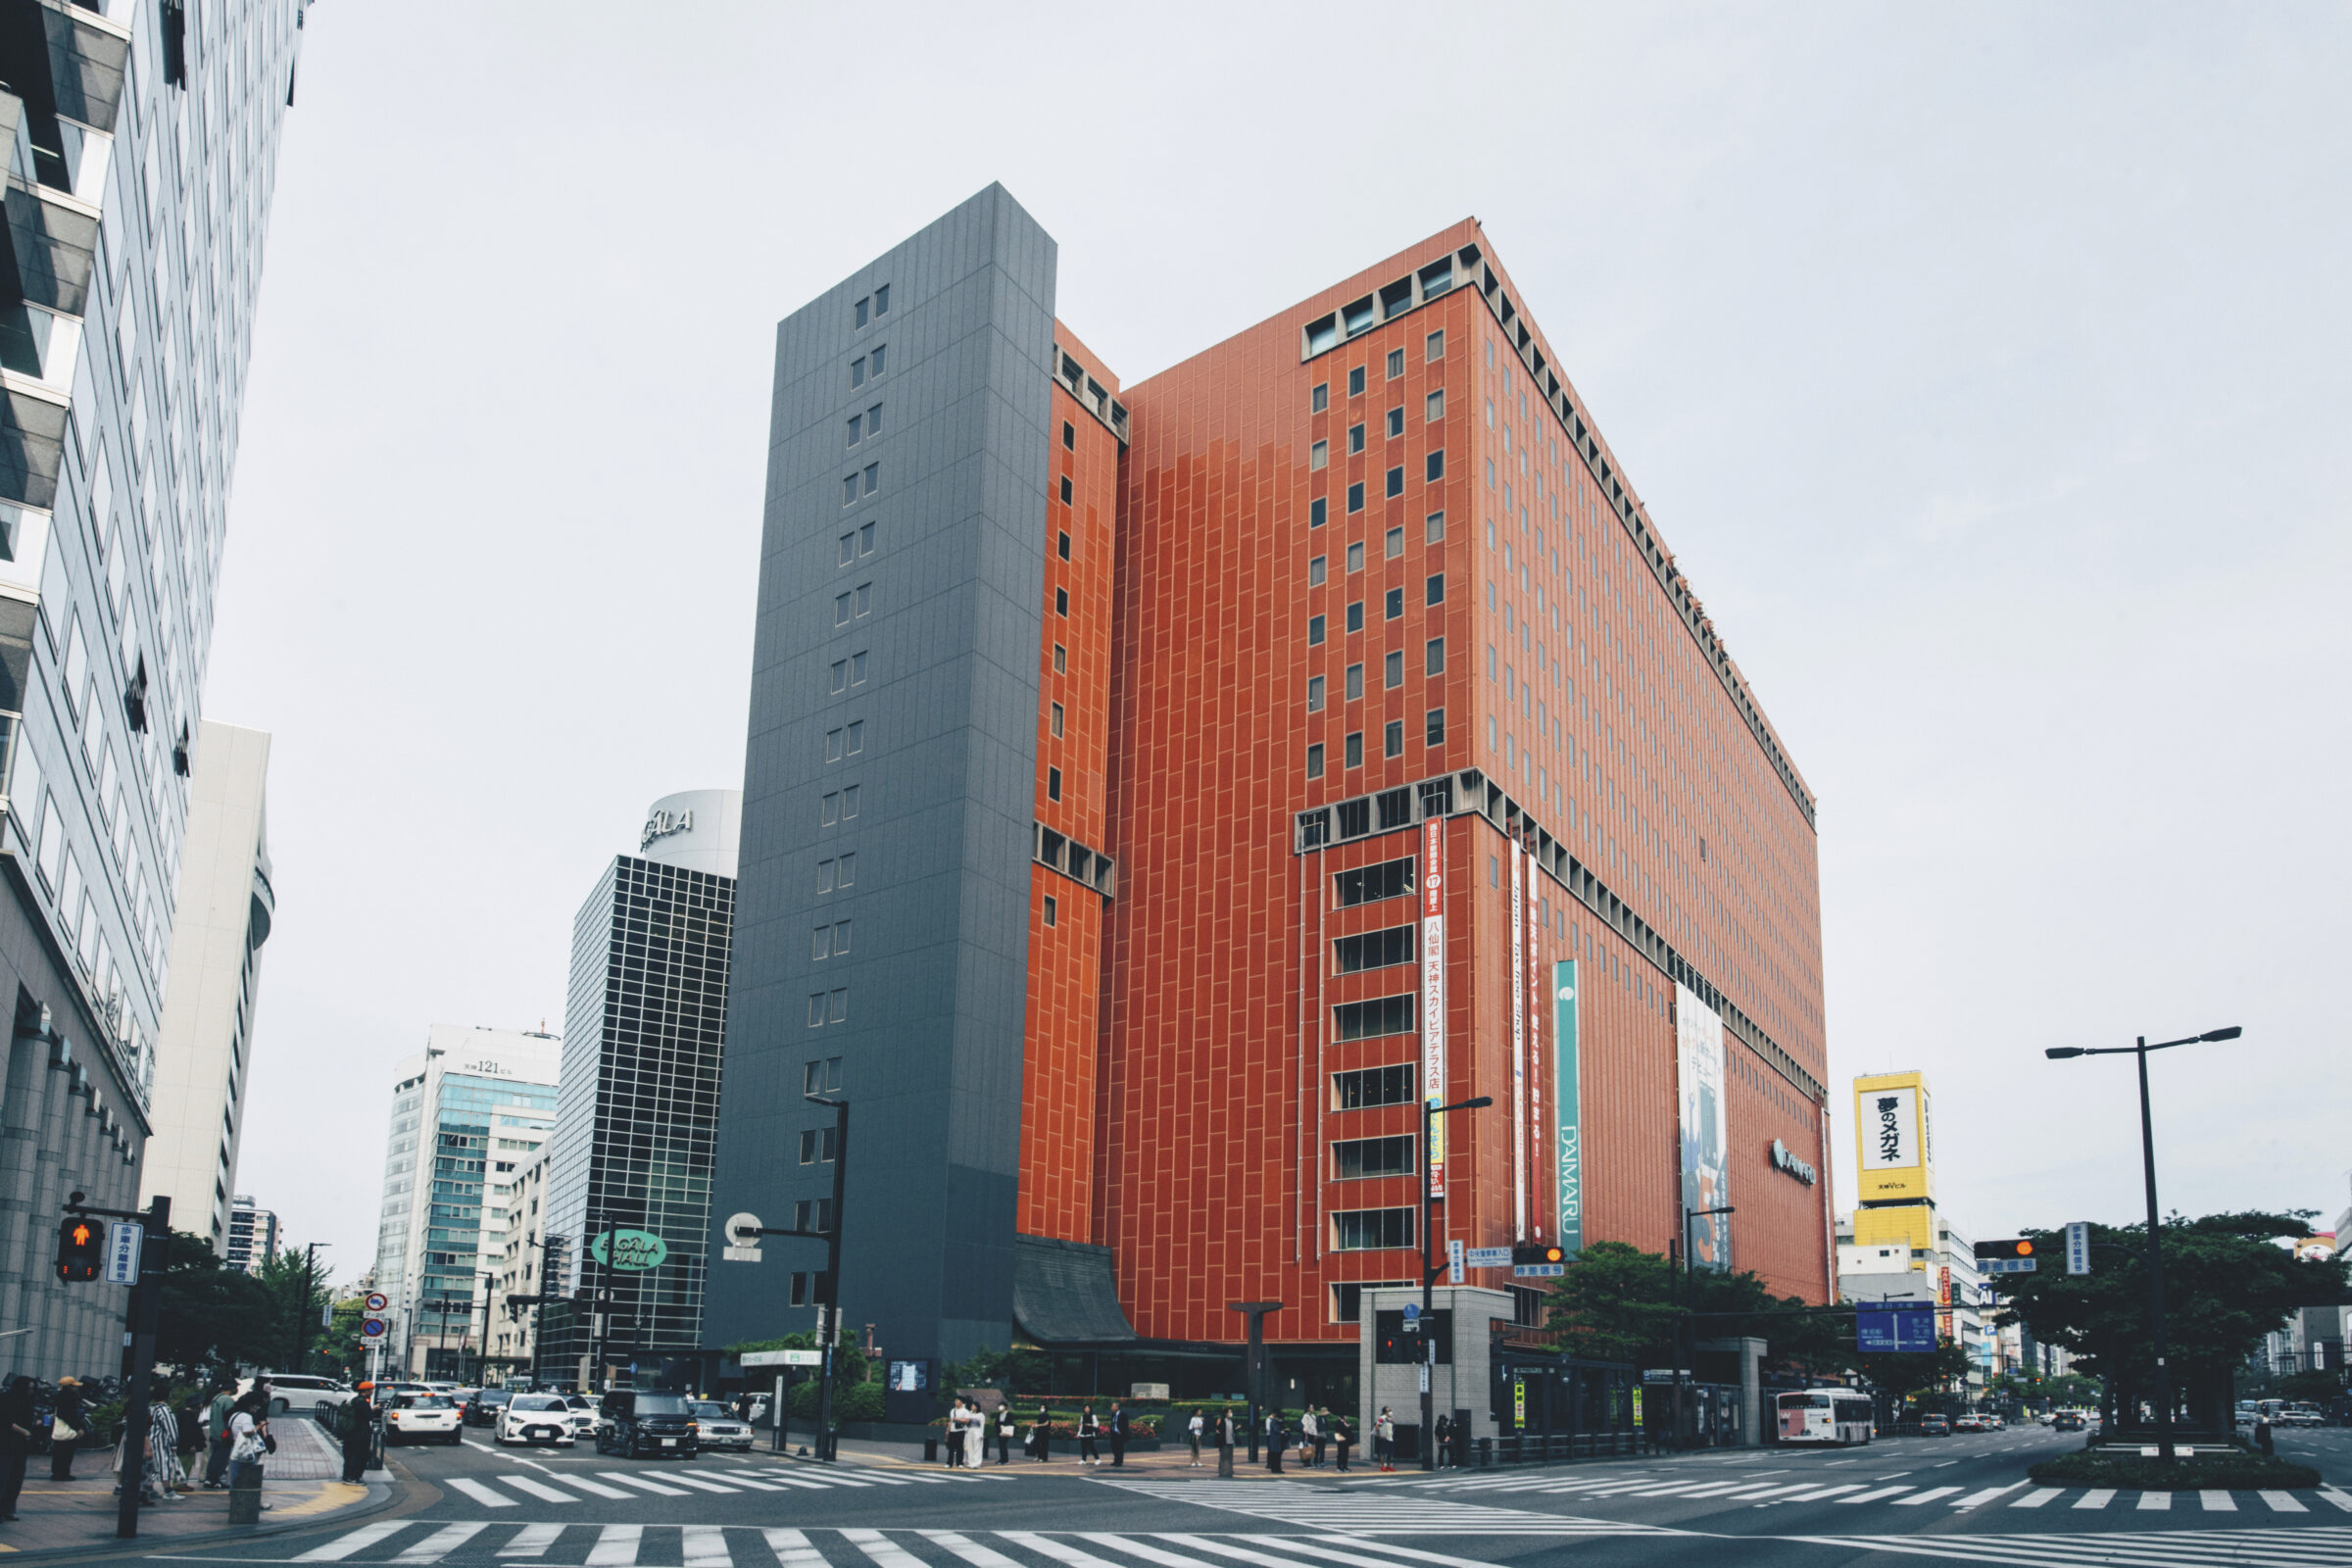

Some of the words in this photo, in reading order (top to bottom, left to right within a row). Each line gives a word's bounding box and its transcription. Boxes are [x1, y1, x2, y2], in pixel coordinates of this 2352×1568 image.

[1429, 921, 1440, 956] 八仙閣
[1429, 960, 1440, 1090] 天神スカイビアテラス店
[1877, 1097, 1900, 1162] 夢のメガネ
[1561, 1125, 1579, 1234] DAIMARU
[116, 1225, 132, 1281] 歩車分離信号
[612, 1250, 649, 1267] HALL
[1515, 1265, 1562, 1276] 時差信号
[1977, 1259, 2034, 1272] 時差信号
[2072, 1225, 2082, 1272] 歩車分離信号
